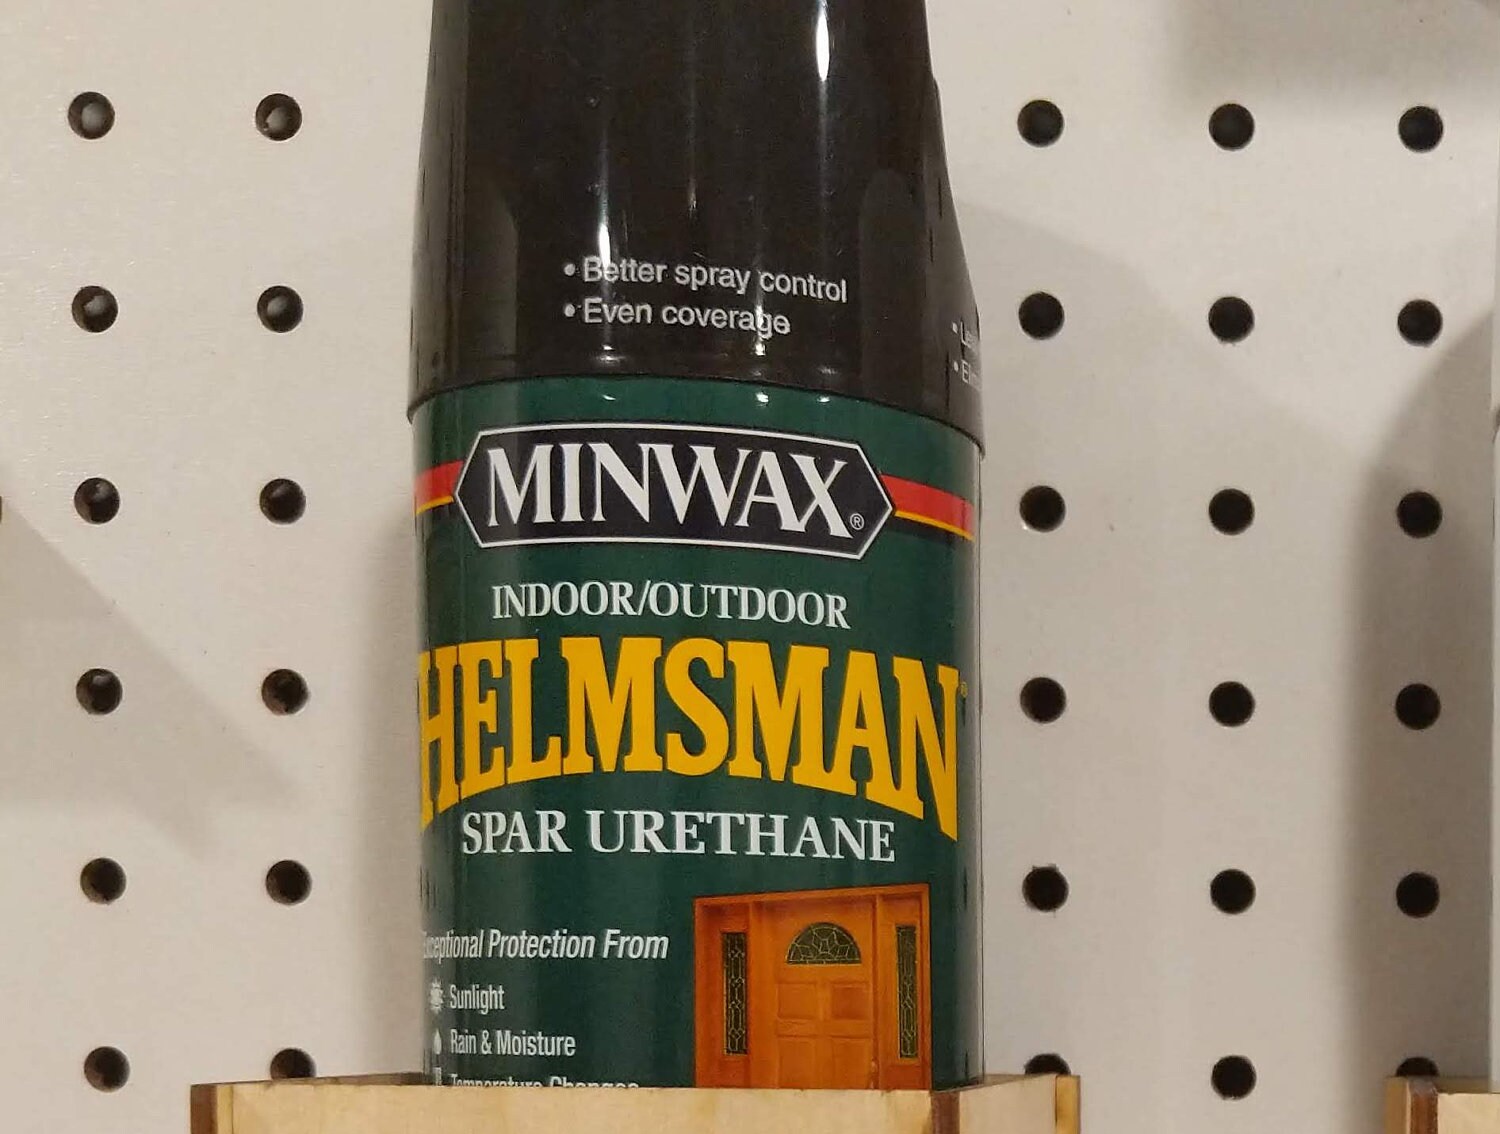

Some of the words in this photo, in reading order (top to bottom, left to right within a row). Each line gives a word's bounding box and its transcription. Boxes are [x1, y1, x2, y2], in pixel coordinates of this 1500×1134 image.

[583, 255, 667, 283] Better
[674, 264, 751, 294] spray
[760, 271, 847, 303] control
[584, 297, 652, 324] Even
[662, 304, 791, 339] coverage
[492, 580, 851, 629] INDOOR/OUTDOOR
[462, 809, 570, 855] SPAR
[585, 809, 895, 862] URETHANE
[488, 928, 596, 959] Protection
[603, 928, 669, 959] From
[450, 984, 505, 1014] Sunlight
[450, 1029, 477, 1054] Rain
[481, 1030, 493, 1055] &
[496, 1030, 577, 1056] Moisture
